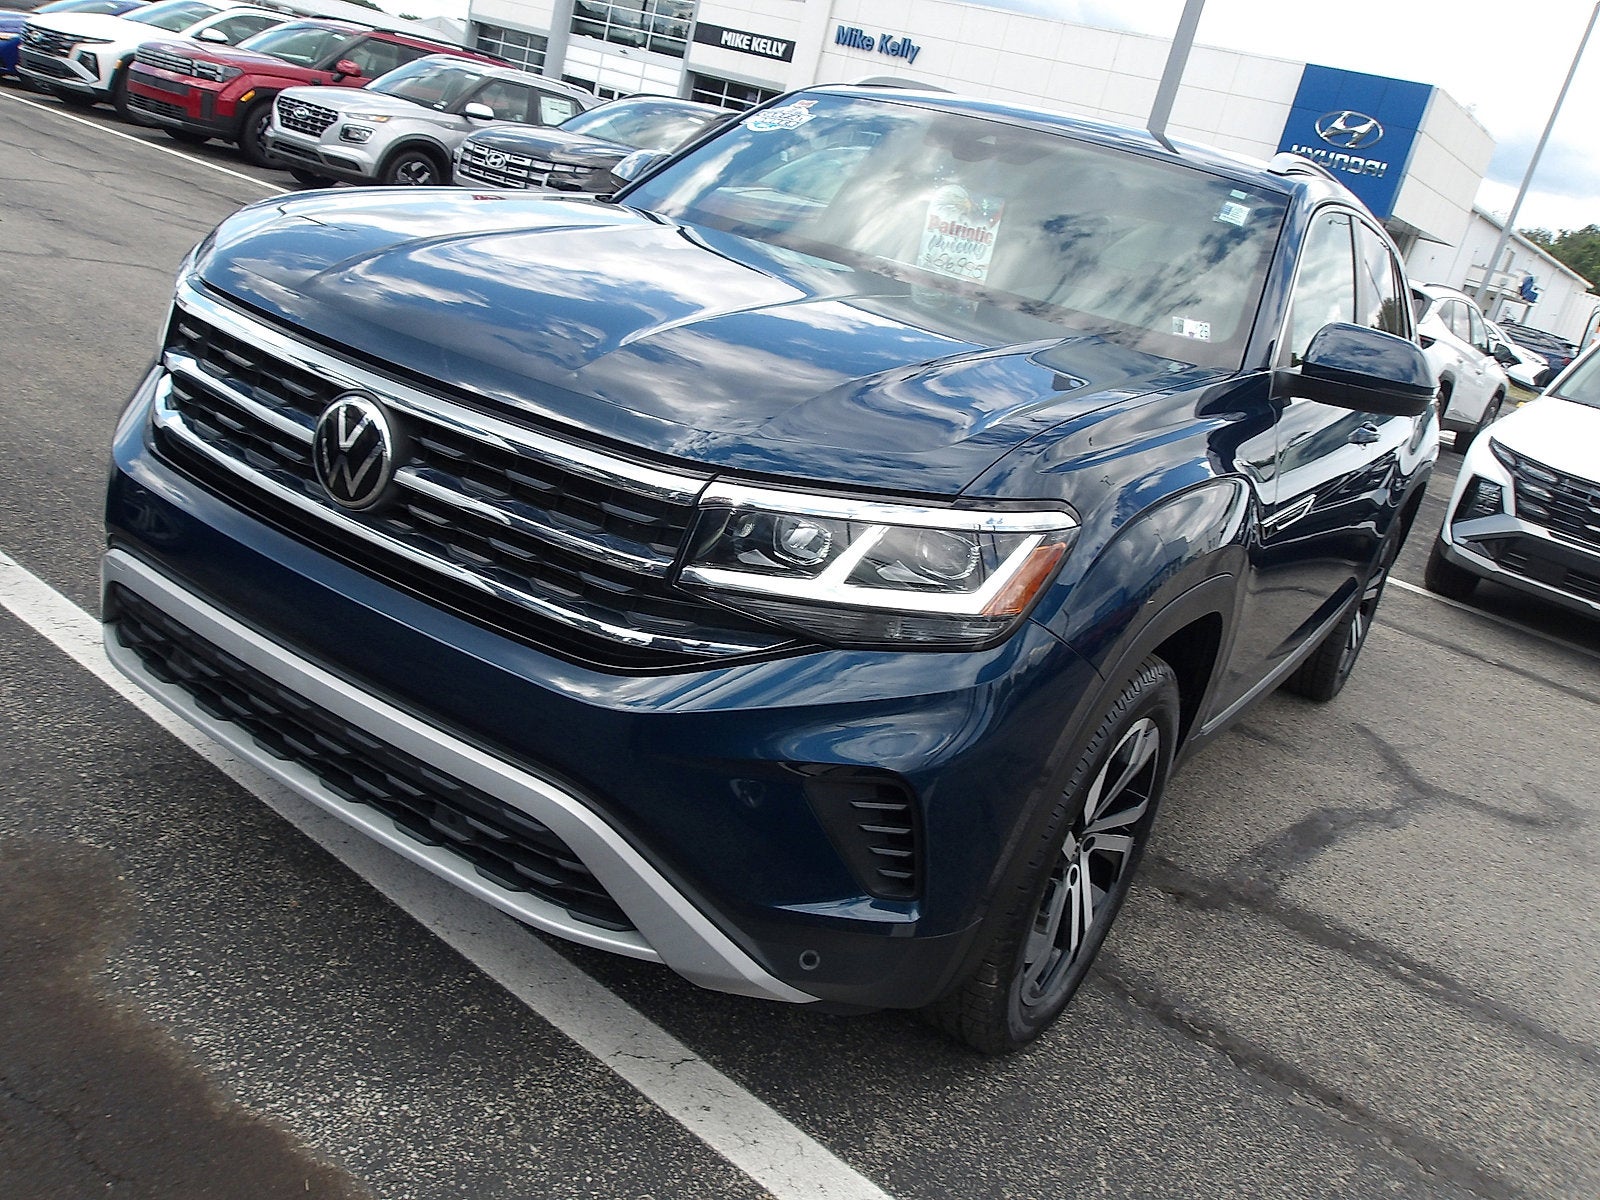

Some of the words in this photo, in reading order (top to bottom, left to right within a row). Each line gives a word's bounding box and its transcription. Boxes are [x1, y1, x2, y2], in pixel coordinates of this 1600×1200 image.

[720, 30, 750, 51] MIKE
[750, 37, 787, 57] KELLY
[834, 25, 874, 52] Mike
[877, 33, 921, 65] Kelly
[1291, 144, 1388, 178] HYUNDAI
[927, 214, 994, 247] Patriotic
